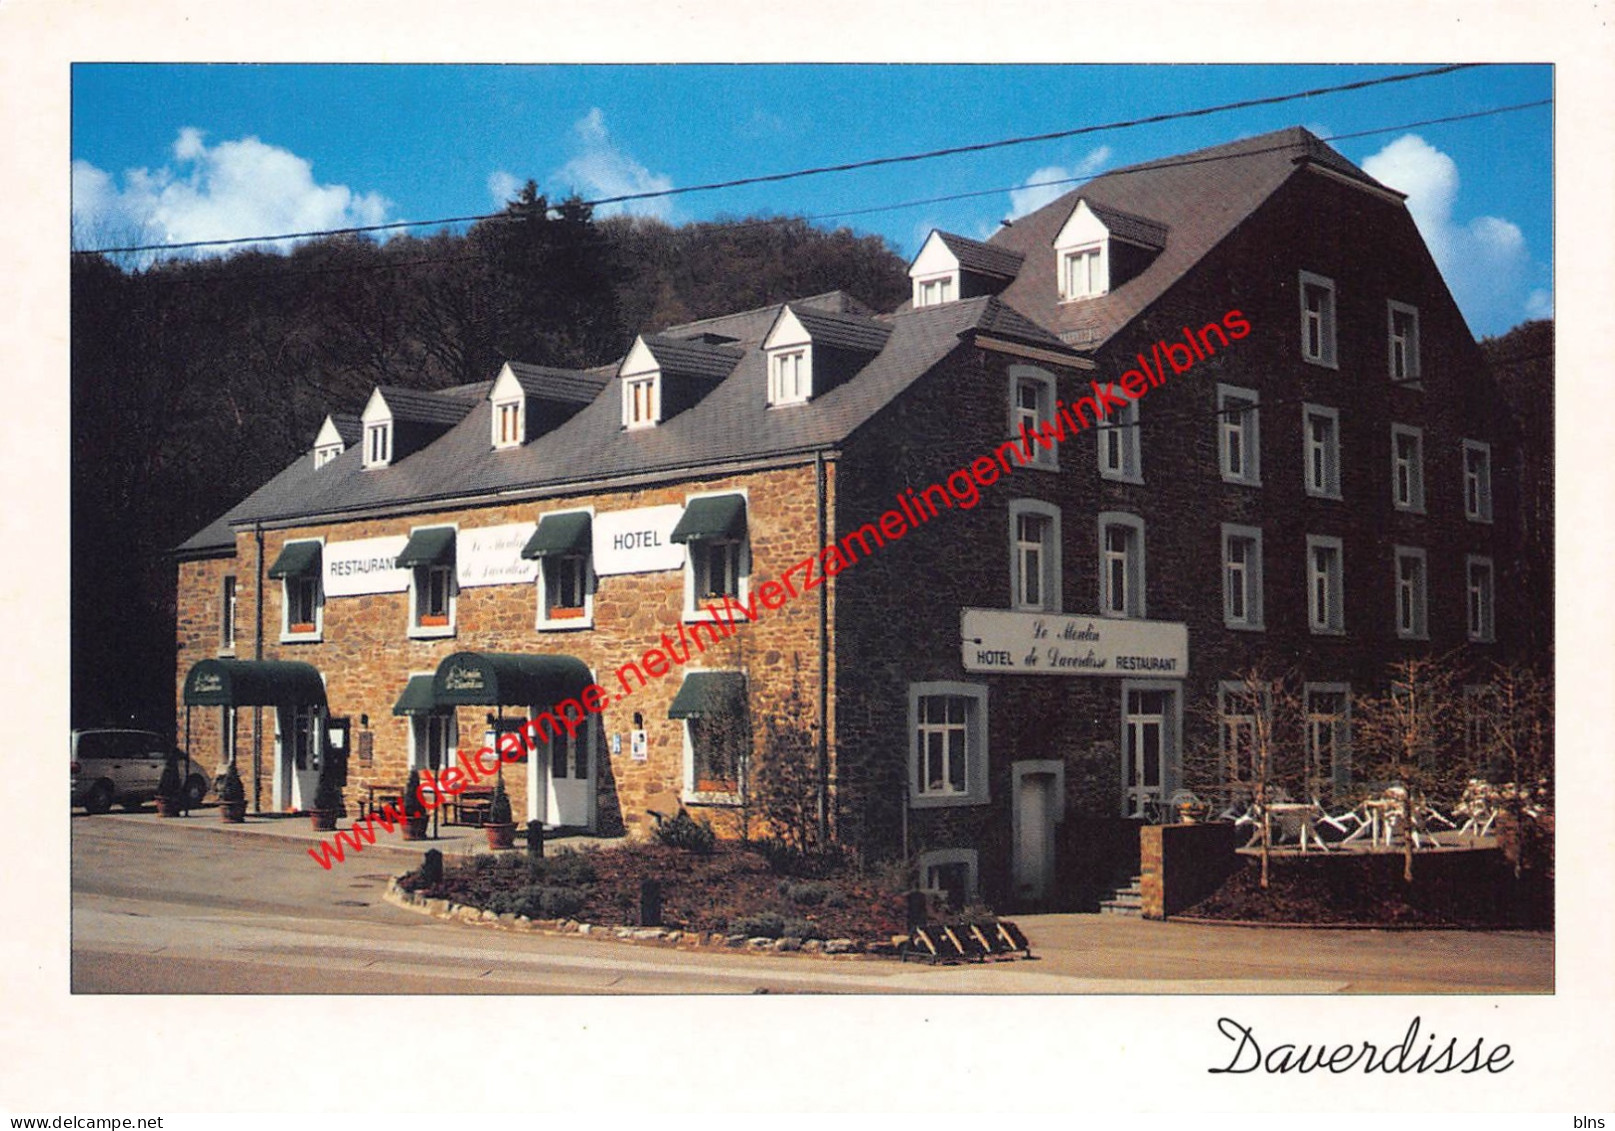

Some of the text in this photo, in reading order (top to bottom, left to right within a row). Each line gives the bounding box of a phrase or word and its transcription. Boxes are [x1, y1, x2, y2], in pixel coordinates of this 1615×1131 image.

[613, 530, 663, 552] HOTEL
[976, 650, 1014, 667] HOTEL
[1024, 647, 1038, 668] de
[1115, 656, 1178, 671] RESTAURANT
[1207, 1016, 1514, 1074] Daverdisse
